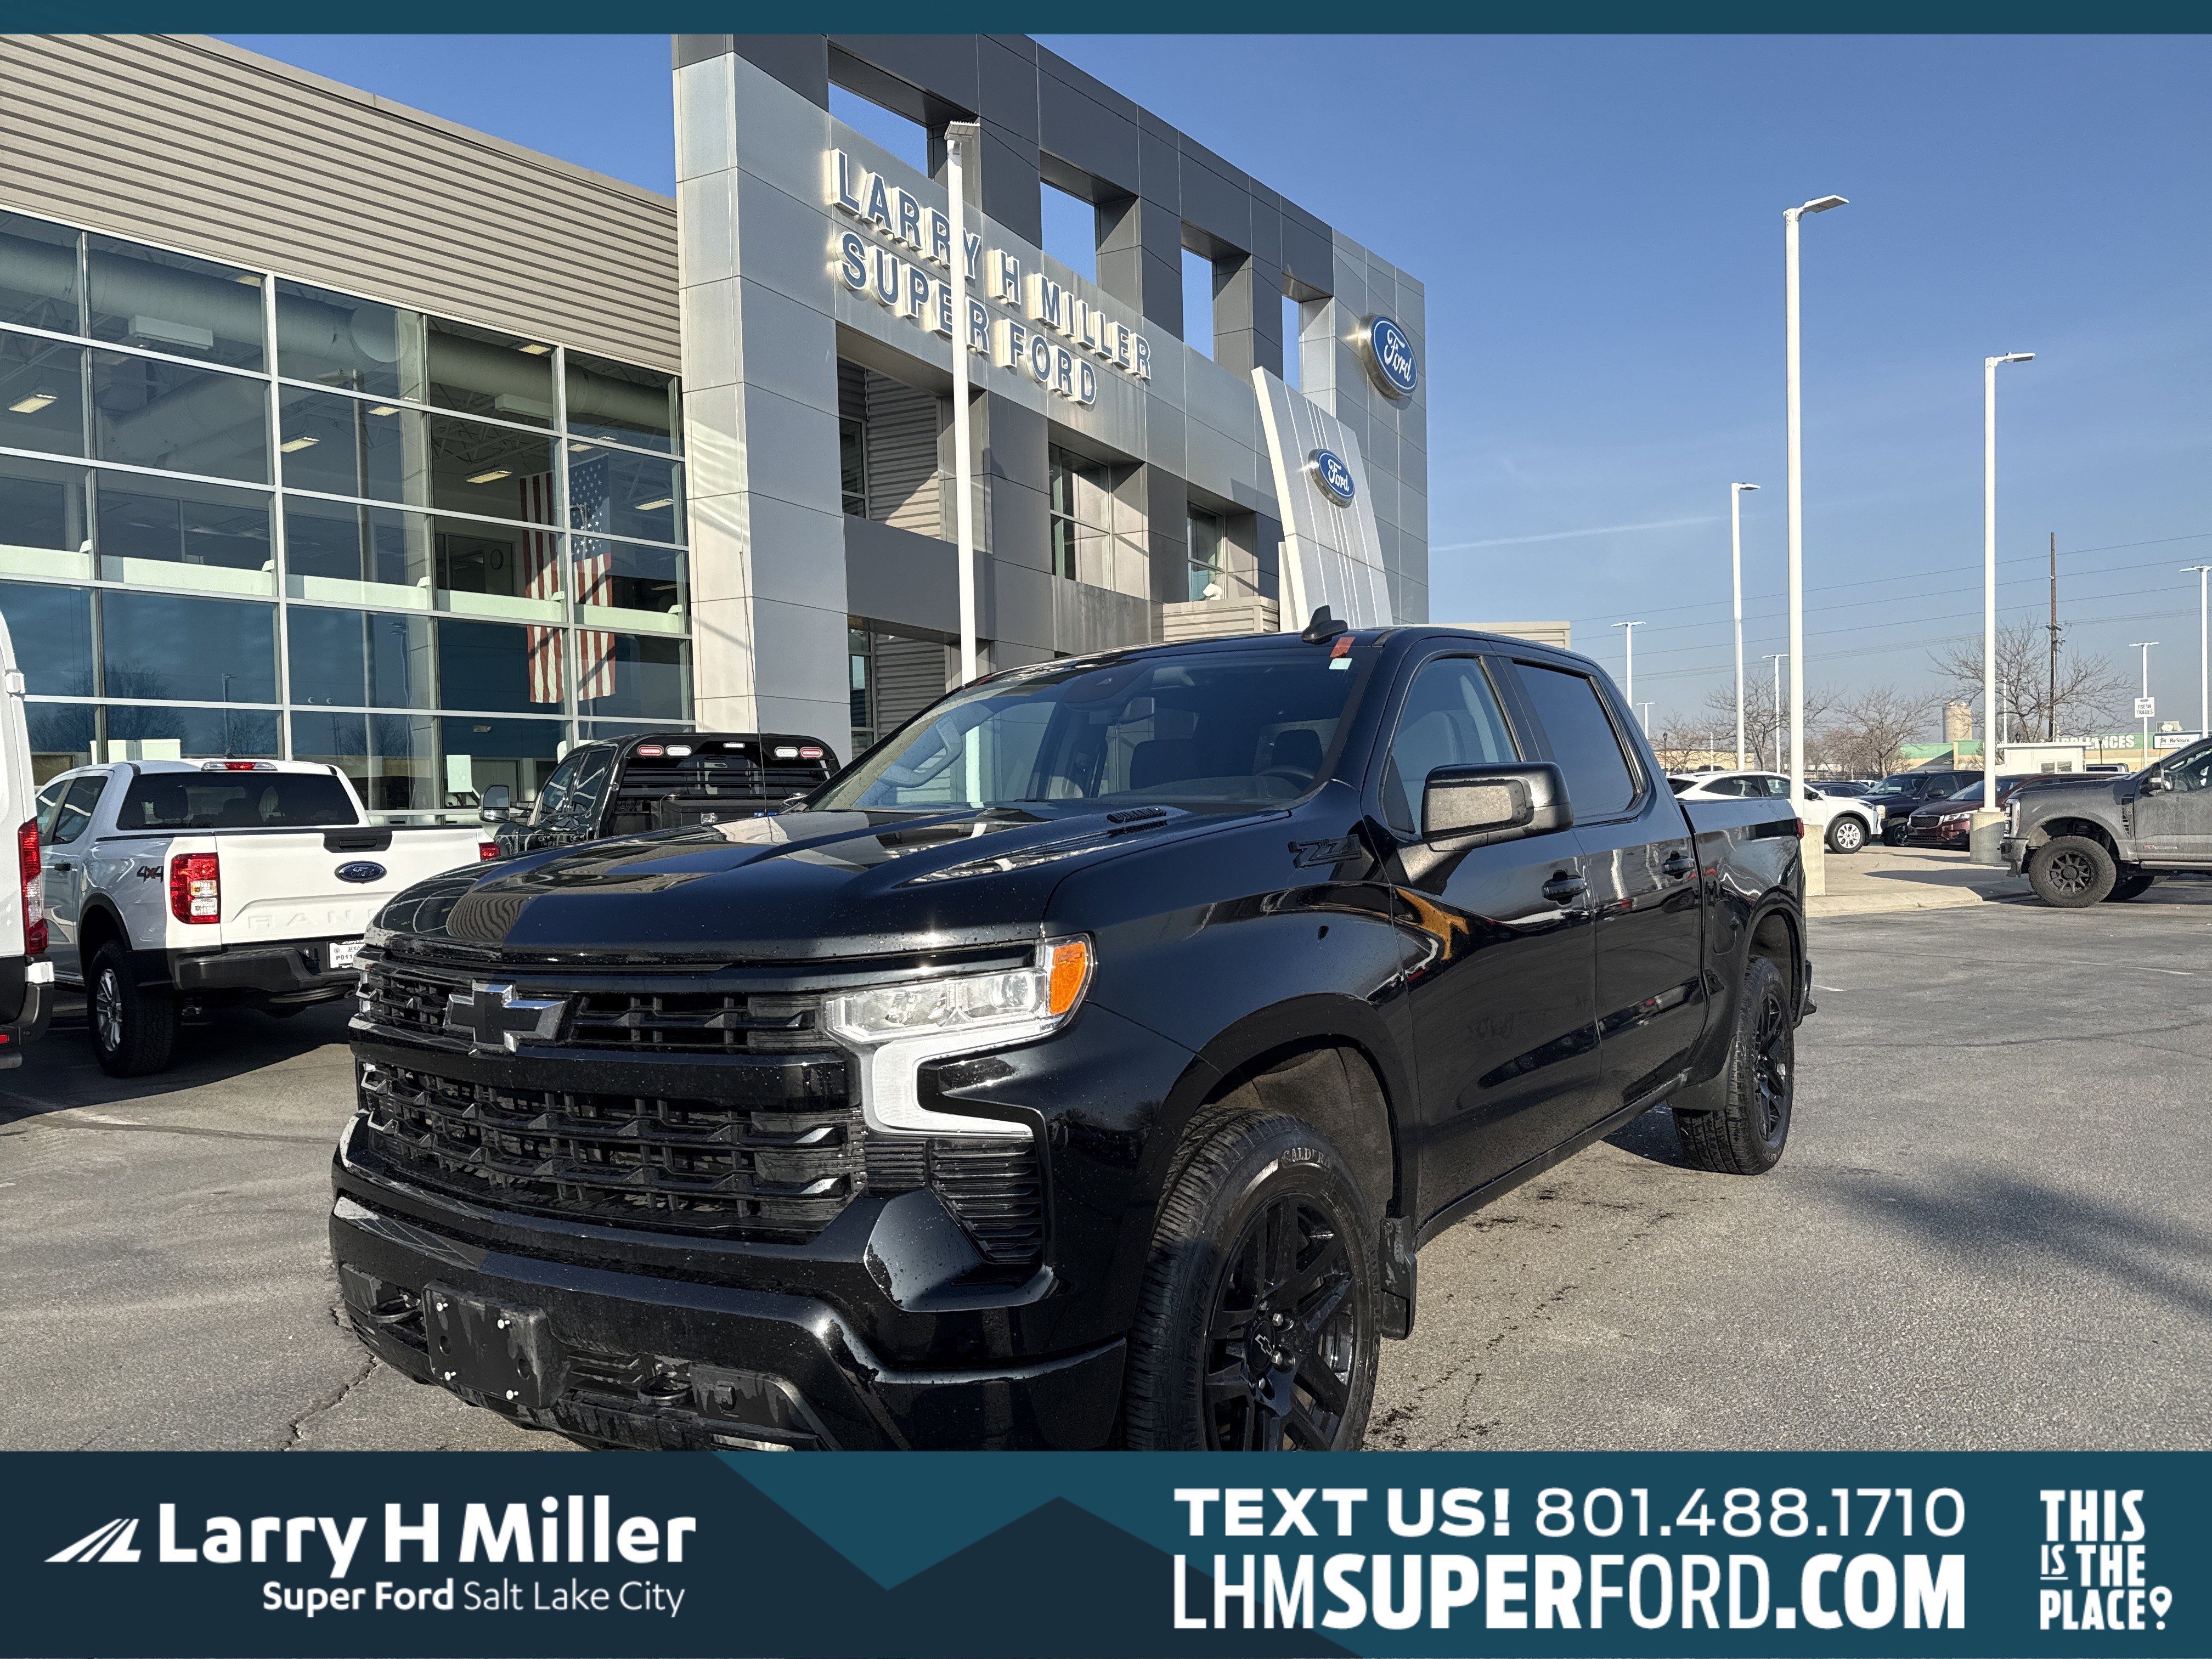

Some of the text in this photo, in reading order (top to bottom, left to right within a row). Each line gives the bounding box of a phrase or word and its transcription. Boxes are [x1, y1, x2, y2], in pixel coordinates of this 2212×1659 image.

[832, 148, 1151, 380] LARRY H MILLER
[837, 231, 1097, 405] SUPER FORD
[1384, 329, 1412, 382] Ford
[1328, 459, 1350, 492] Ford
[349, 866, 375, 877] Ford
